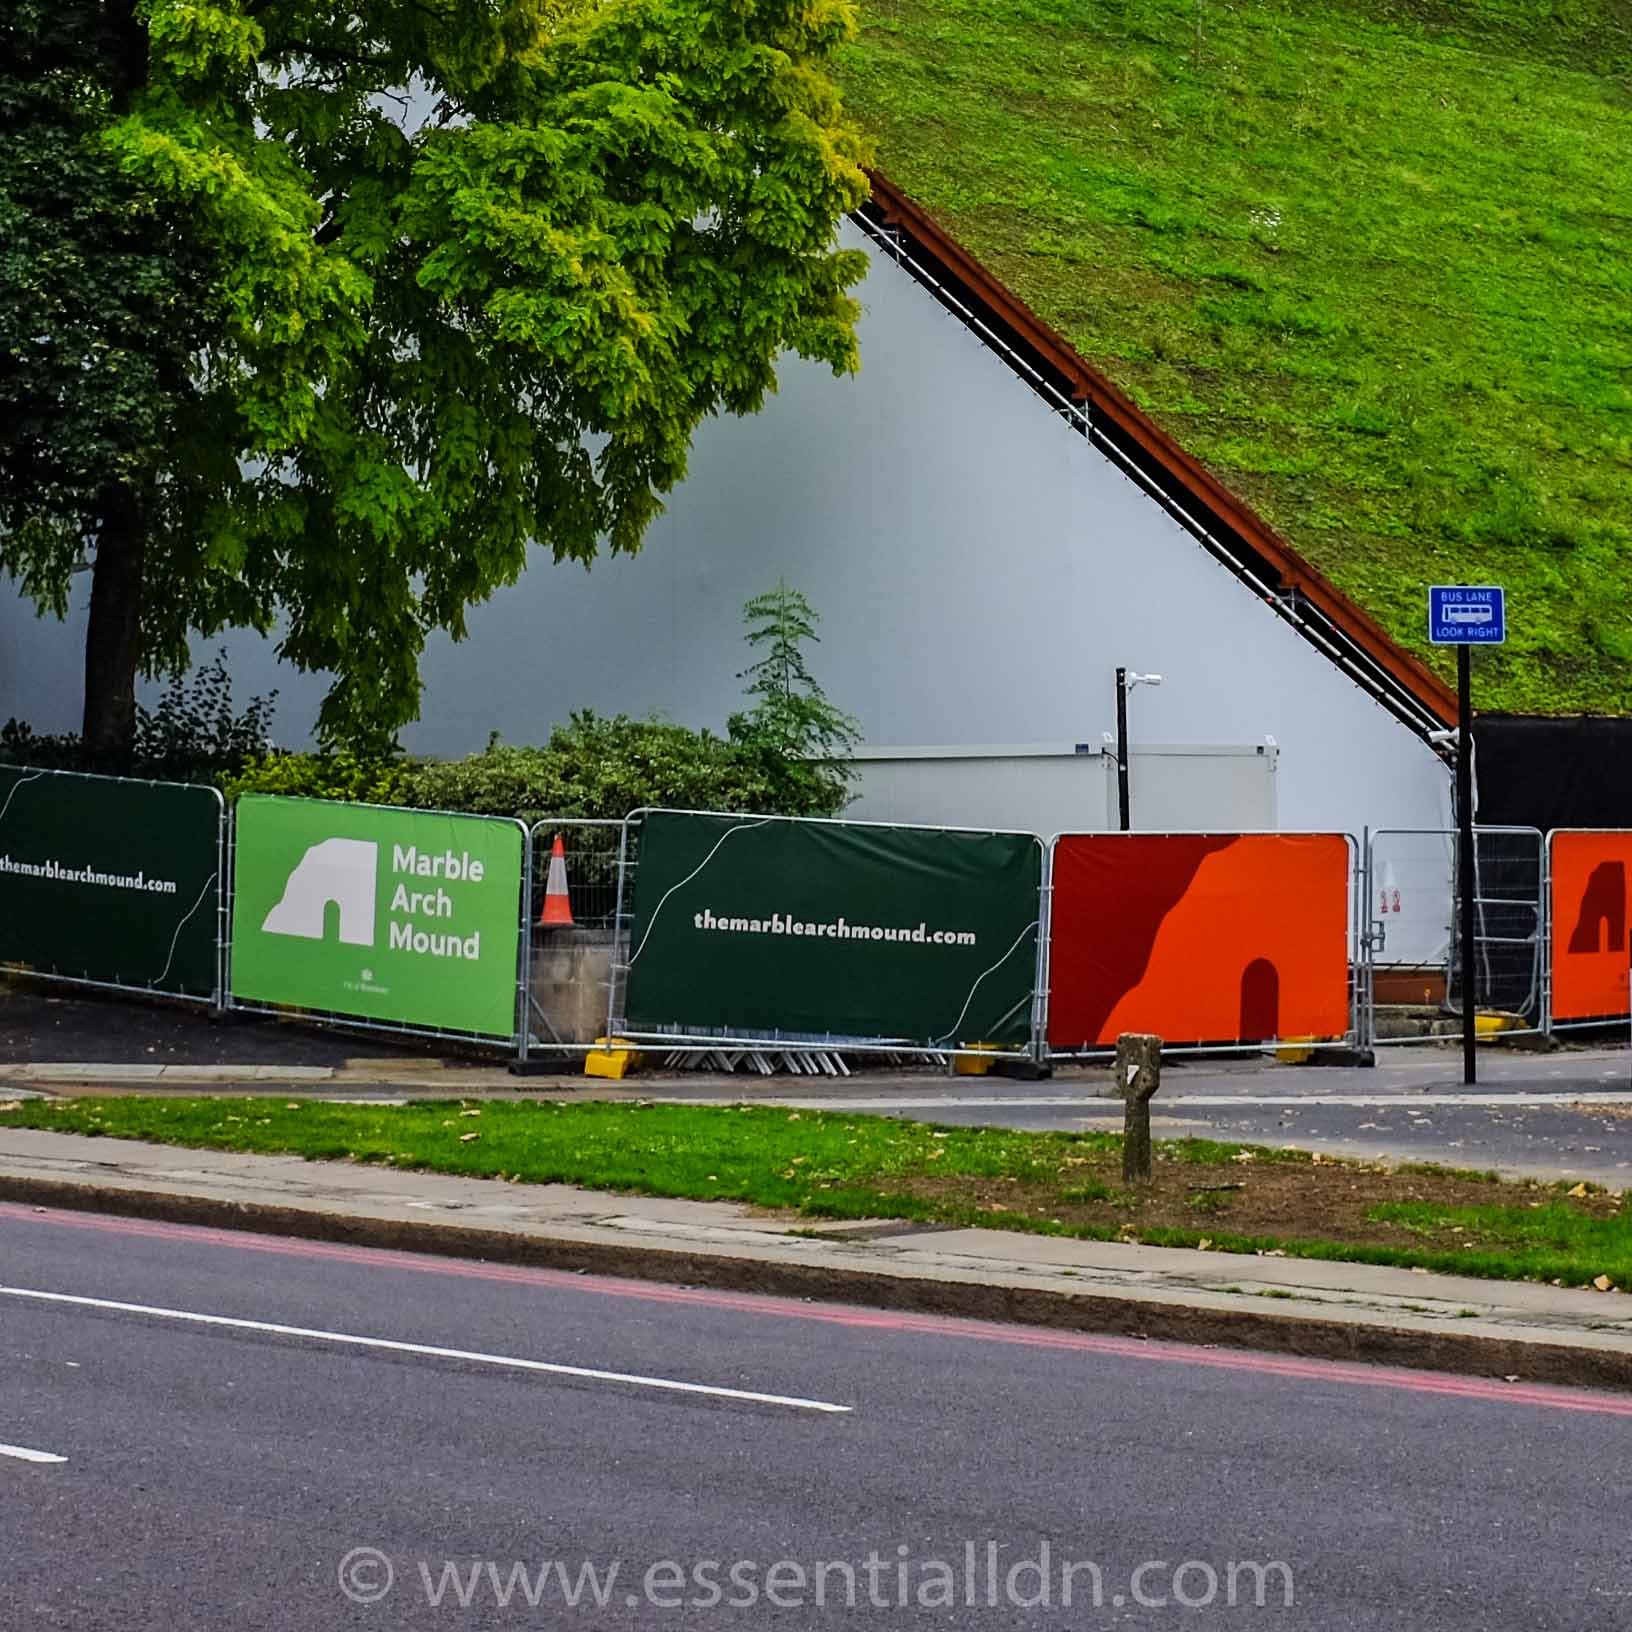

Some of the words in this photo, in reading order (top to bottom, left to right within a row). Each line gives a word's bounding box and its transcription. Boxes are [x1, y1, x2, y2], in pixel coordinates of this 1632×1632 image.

[1441, 592, 1463, 602] BUS
[1465, 592, 1492, 602] LANE
[1436, 627, 1464, 638] LOOK
[1467, 627, 1499, 638] RIGHT
[0, 854, 177, 893] themarblearchmound.com
[393, 844, 484, 882] Marble
[390, 883, 452, 918] Arch
[389, 921, 480, 961] Mound
[694, 909, 976, 945] themarblearchmound.com
